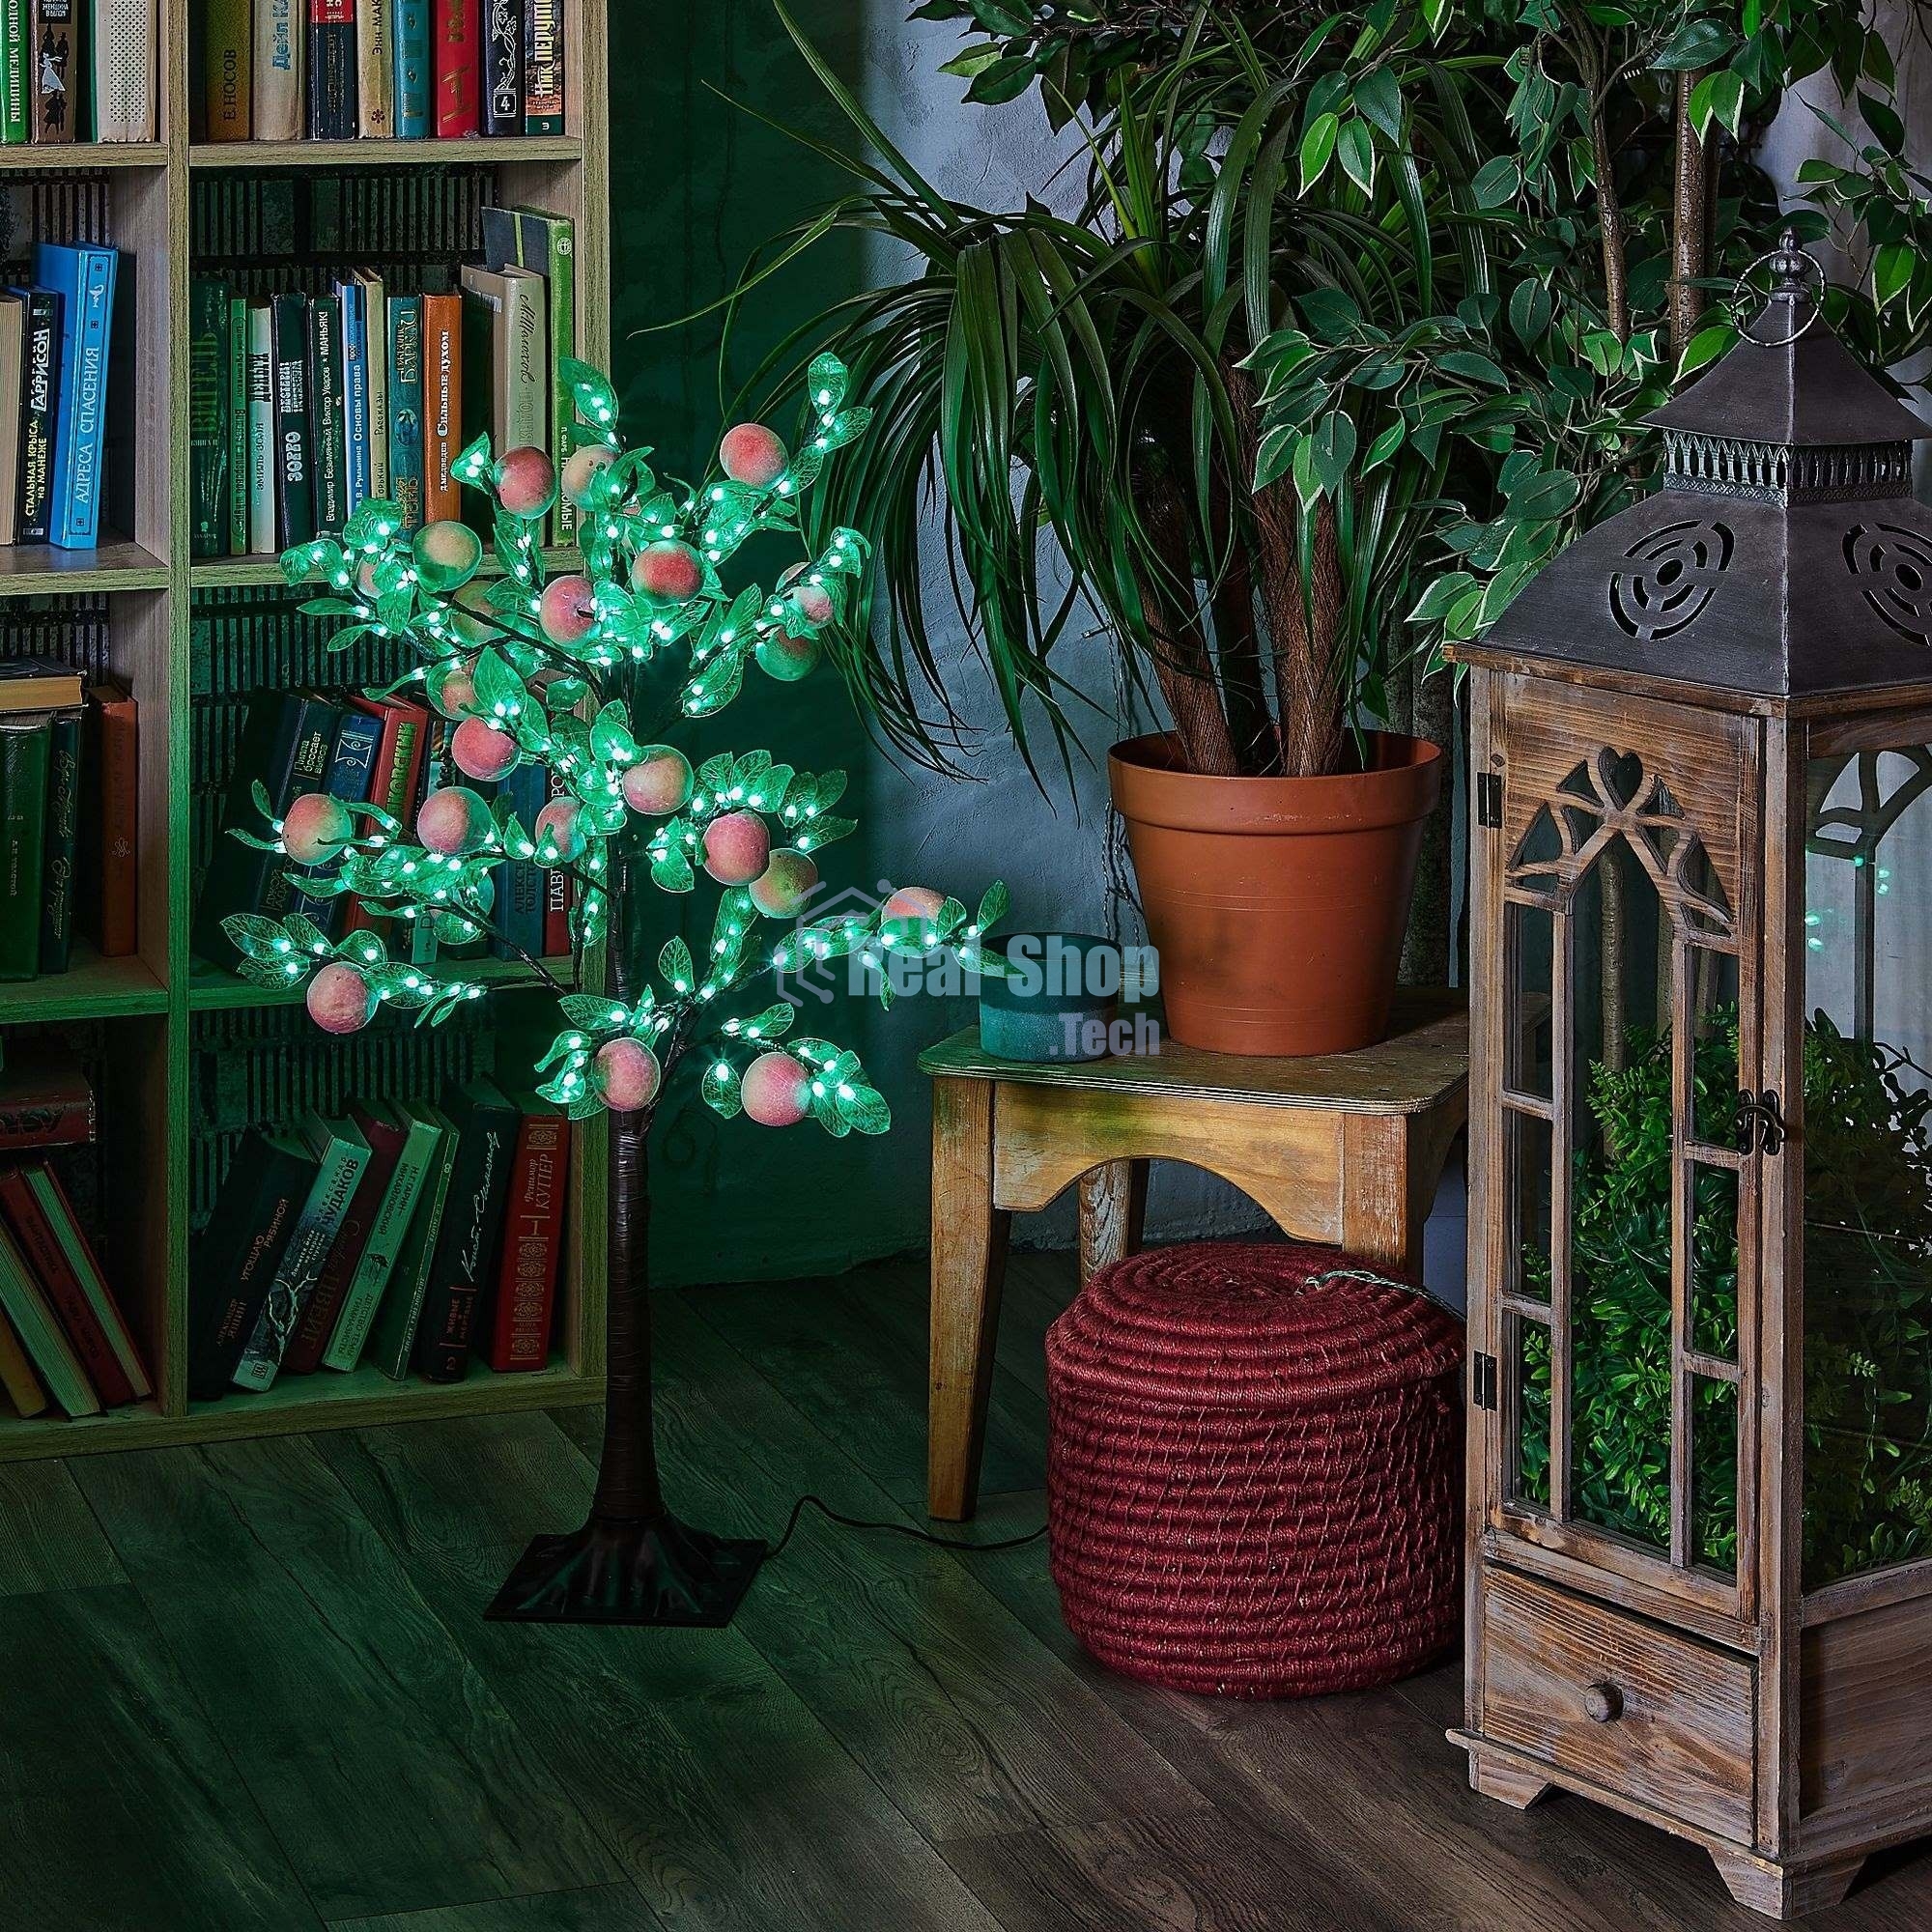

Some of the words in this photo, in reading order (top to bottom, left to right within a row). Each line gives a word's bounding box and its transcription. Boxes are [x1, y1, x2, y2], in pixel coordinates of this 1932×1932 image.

[272, 21, 291, 71] Дейл
[372, 32, 383, 56] Энн
[9, 47, 20, 123] МЕДИЦИНЫ
[500, 96, 511, 111] 4
[319, 311, 329, 355] МАНЬЯК!
[440, 330, 452, 373] духом
[31, 327, 50, 412] ГАРРИСОН
[80, 346, 100, 434] СПАСЕНИЯ
[191, 332, 219, 432] ВИГЕЛЬ
[247, 353, 271, 403] ДЕНЬГИ
[321, 367, 332, 396] Уваров
[353, 364, 362, 397] права
[323, 397, 332, 425] Виктор
[353, 399, 363, 442] Основы
[437, 375, 449, 437] Сильные
[516, 392, 534, 448] ПОДНЯ
[27, 419, 39, 458] КРЫСА
[37, 438, 47, 484] МАНЕЖЕ
[285, 431, 304, 482] ЗОРРО
[25, 461, 37, 517] СТАЛЬНАЯ
[75, 443, 94, 504] АДРЕСА
[355, 446, 364, 487] Румынина
[37, 487, 45, 499] на
[326, 481, 336, 522] Владимир
[304, 731, 322, 773] бросает
[314, 743, 328, 774] вызов
[514, 861, 526, 914] АЛЕКСЕ
[322, 1157, 360, 1228] ЧУДАКОВ
[378, 1162, 410, 1236] МИХАЙЛОВСКИЙ
[535, 1152, 554, 1209] КУПЕР
[263, 1198, 290, 1248] РЯБИНОЙ
[239, 1234, 266, 1283] УГОЩАЮ
[338, 1297, 362, 1354] ГИМНАЗИСТЫ
[355, 1293, 374, 1331] ДЕТСТВО
[347, 1332, 360, 1357] ТЕМЫ
